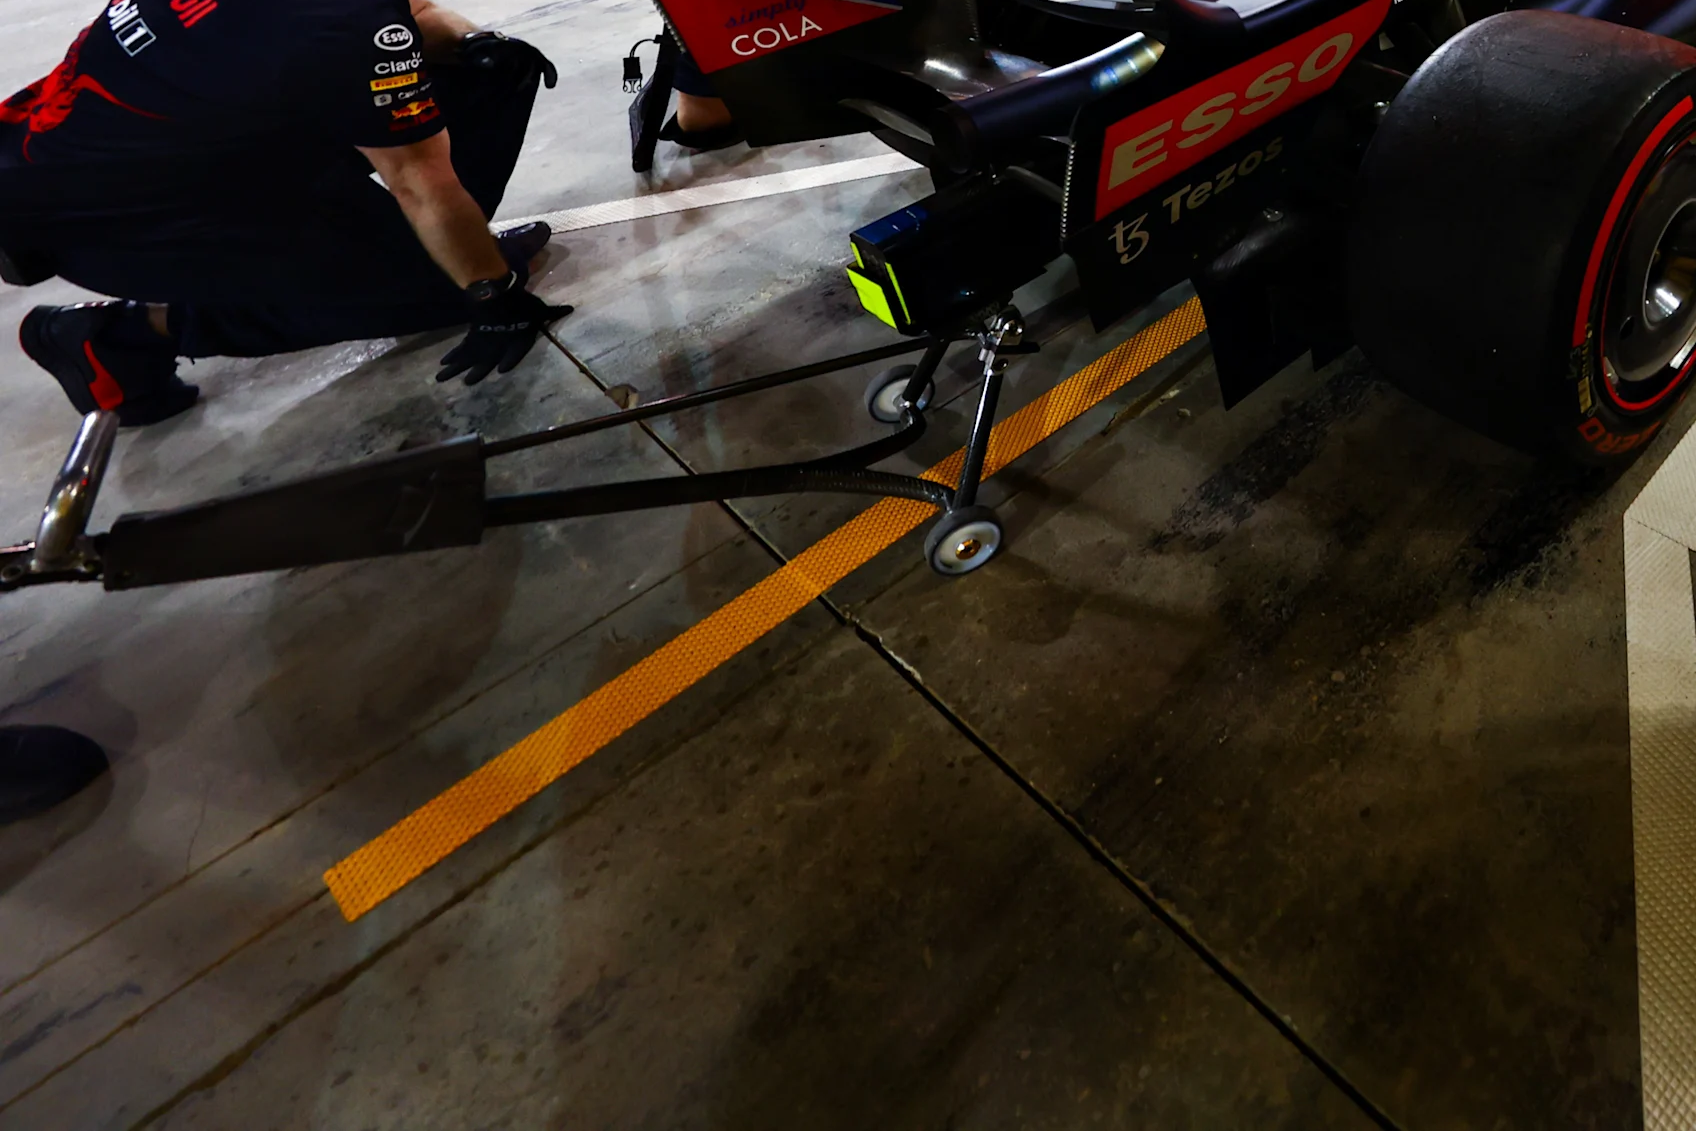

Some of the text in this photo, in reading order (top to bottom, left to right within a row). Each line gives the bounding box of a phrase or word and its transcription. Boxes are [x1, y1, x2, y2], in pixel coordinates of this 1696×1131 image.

[382, 31, 409, 44] Esso
[731, 15, 823, 57] COLA
[374, 56, 421, 74] Claro
[1108, 33, 1353, 190] ESSO
[1162, 136, 1283, 224] Tezos
